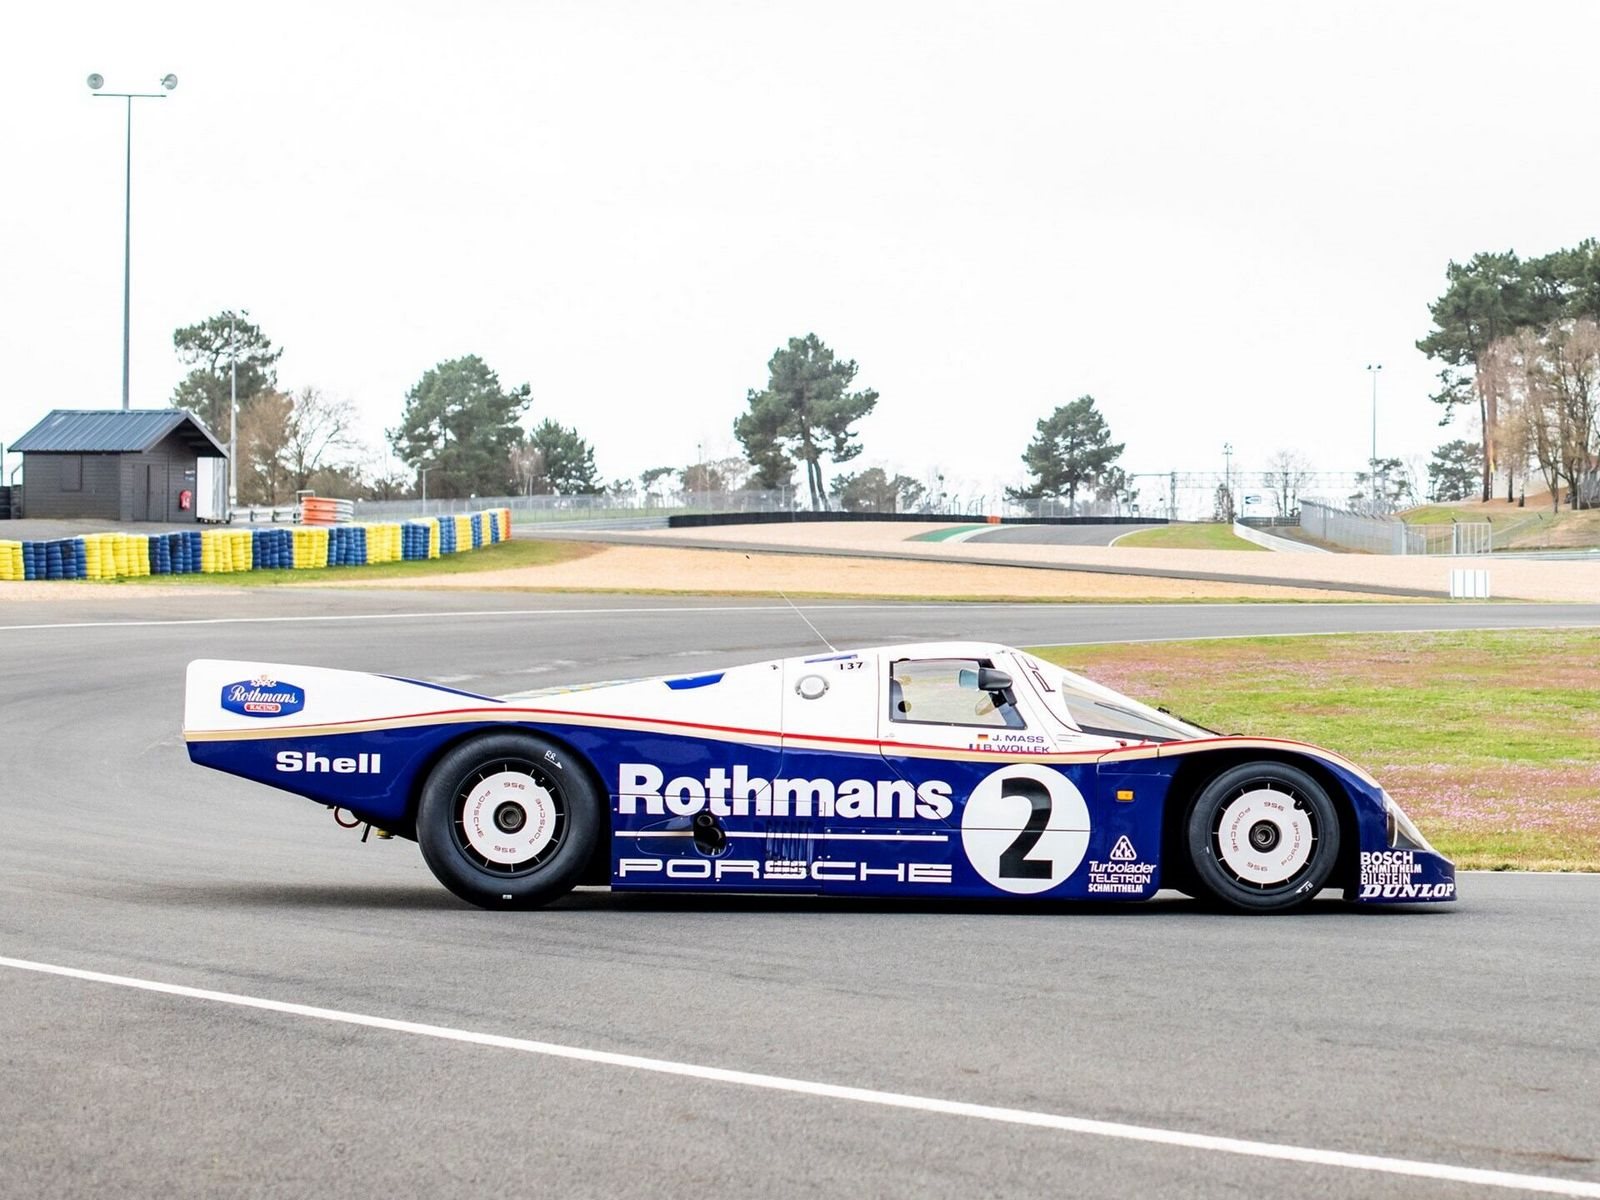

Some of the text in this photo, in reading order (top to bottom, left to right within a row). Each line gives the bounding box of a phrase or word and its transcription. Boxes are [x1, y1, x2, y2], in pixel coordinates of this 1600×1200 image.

[840, 661, 863, 671] 137
[228, 684, 299, 704] Rothmans
[992, 734, 1045, 743] J. MASS
[983, 744, 1050, 755] B. WOLLEK
[276, 751, 381, 773] Shell
[503, 781, 526, 790] 956
[618, 763, 953, 820] Rothmans
[1263, 801, 1285, 812] 956
[473, 790, 492, 838] PORSCHE
[528, 798, 546, 845] PORSCHE
[998, 777, 1054, 879] 2
[1230, 807, 1251, 853] PORSCHE
[1281, 821, 1301, 866] PORSCHE
[1360, 851, 1414, 865] BOSCH
[619, 858, 952, 883] PORSCHE
[1089, 861, 1157, 874] Turbolader
[1361, 864, 1422, 873] SCHMITTHELM
[1088, 873, 1151, 884] TELETRON
[1361, 873, 1411, 885] BILSTEIN
[1088, 883, 1143, 893] SCHMITTHELM
[1360, 883, 1455, 898] DUNLOP
